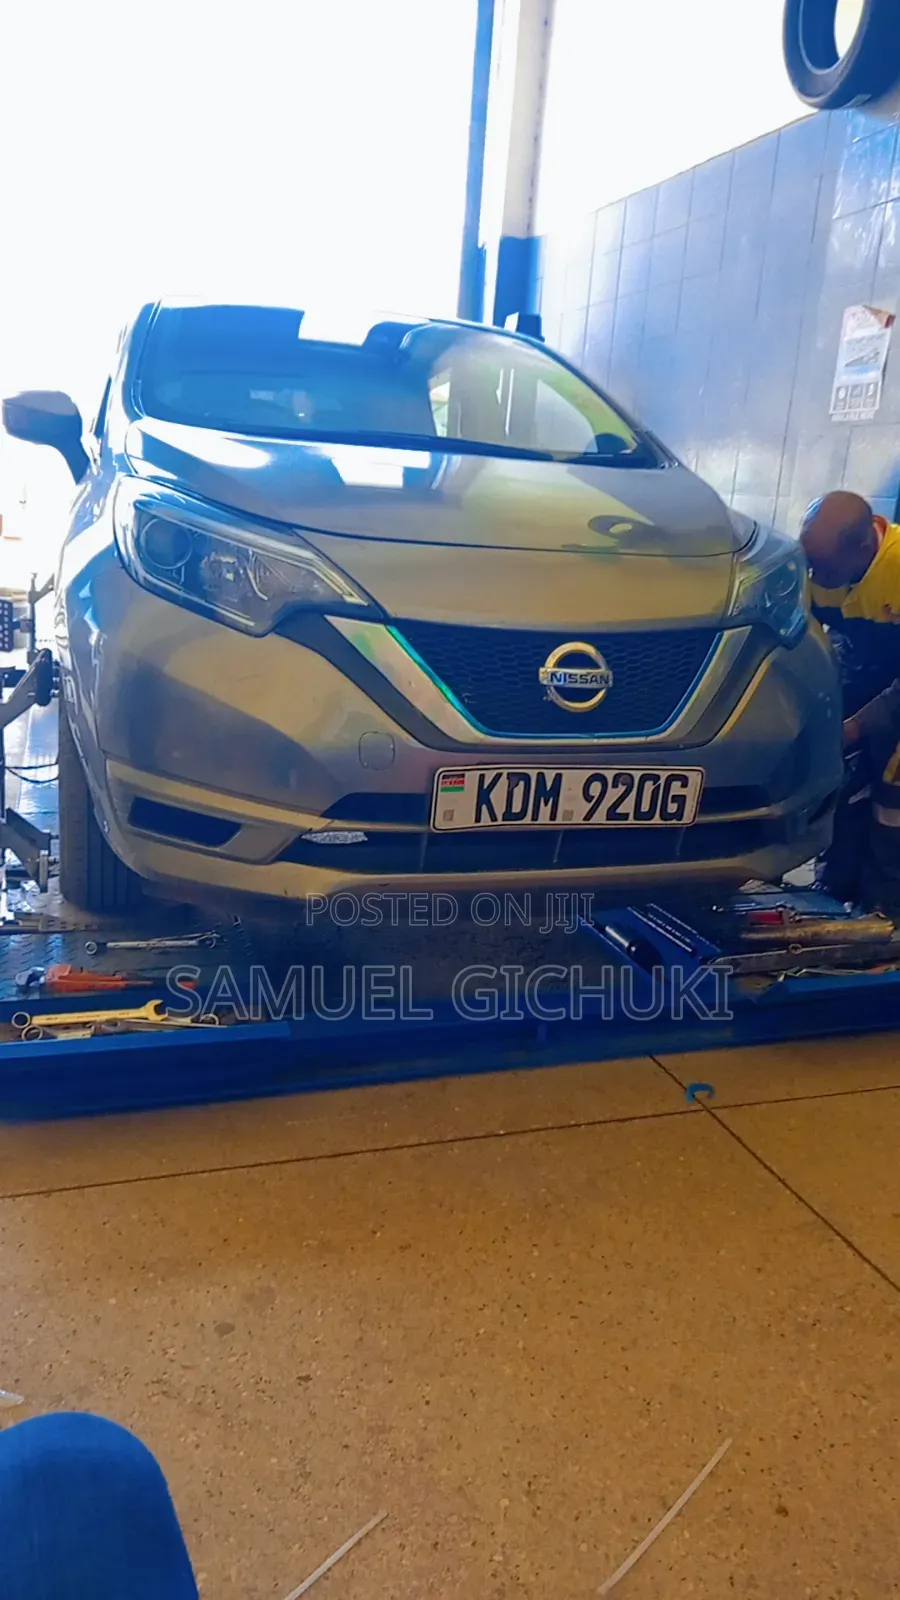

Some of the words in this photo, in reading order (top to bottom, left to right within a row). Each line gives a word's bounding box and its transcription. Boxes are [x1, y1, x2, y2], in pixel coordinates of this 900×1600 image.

[550, 671, 610, 686] NISSAN
[474, 773, 562, 823] KDM
[582, 772, 689, 821] 920G
